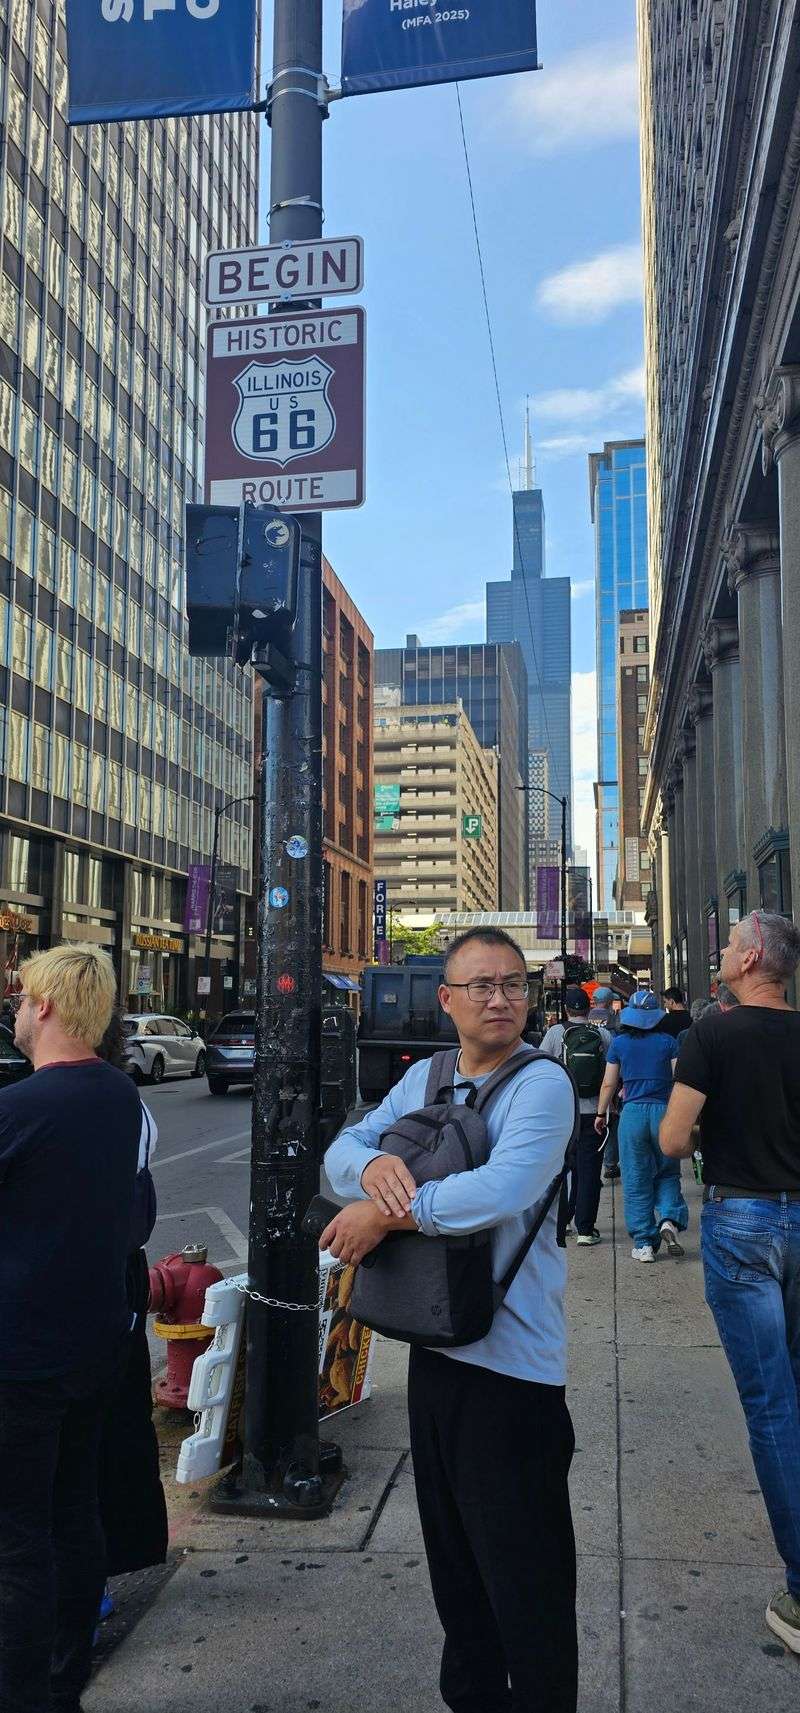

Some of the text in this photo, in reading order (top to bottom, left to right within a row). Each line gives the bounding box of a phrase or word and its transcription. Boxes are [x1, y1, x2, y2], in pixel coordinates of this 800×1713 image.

[401, 9, 470, 30] (MFA 2025)
[218, 248, 347, 295] BEGIN
[227, 320, 343, 352] HISTORIC
[247, 370, 322, 392] ILLINOIS
[252, 408, 317, 452] 66
[242, 477, 324, 504] ROUTE
[375, 882, 385, 935] FORTE
[355, 1327, 371, 1385] CHICKE
